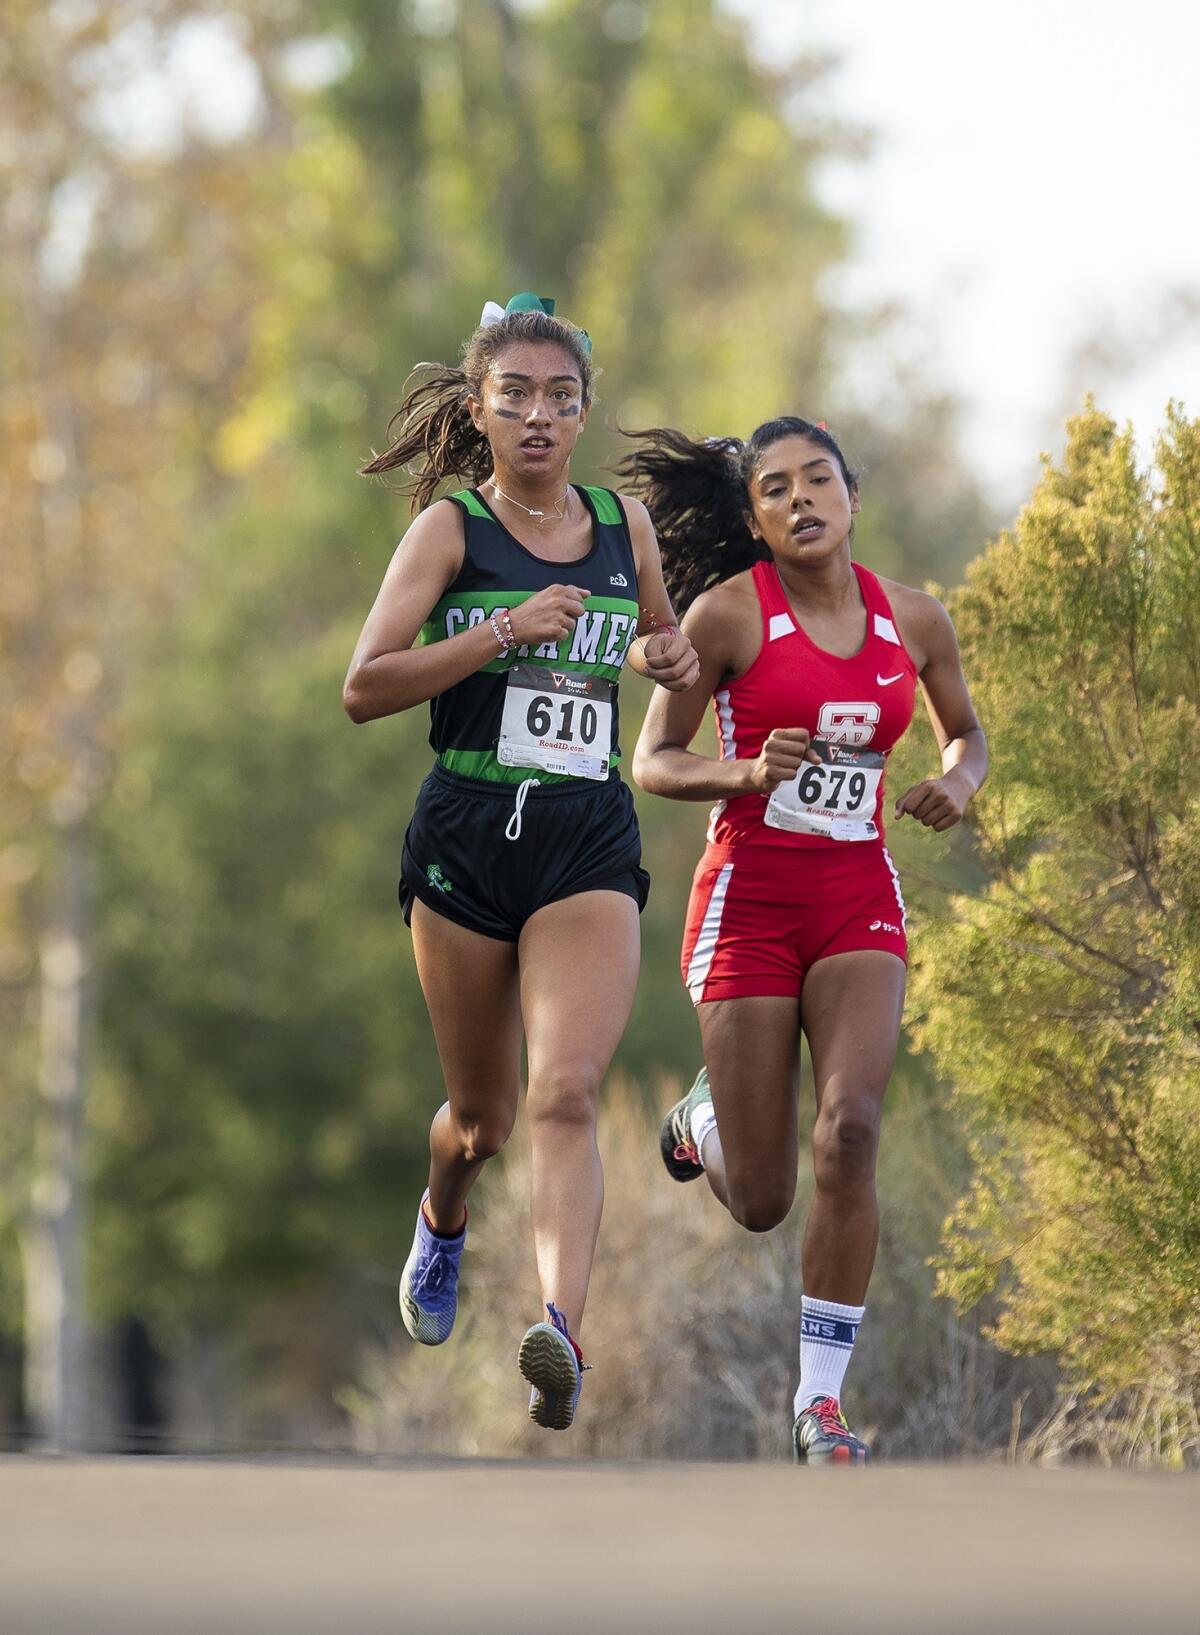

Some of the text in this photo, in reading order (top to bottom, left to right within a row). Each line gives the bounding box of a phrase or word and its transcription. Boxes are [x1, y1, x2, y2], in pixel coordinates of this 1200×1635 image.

[526, 696, 598, 745] 610
[538, 739, 585, 753] RoadID.com
[797, 765, 867, 811] 679
